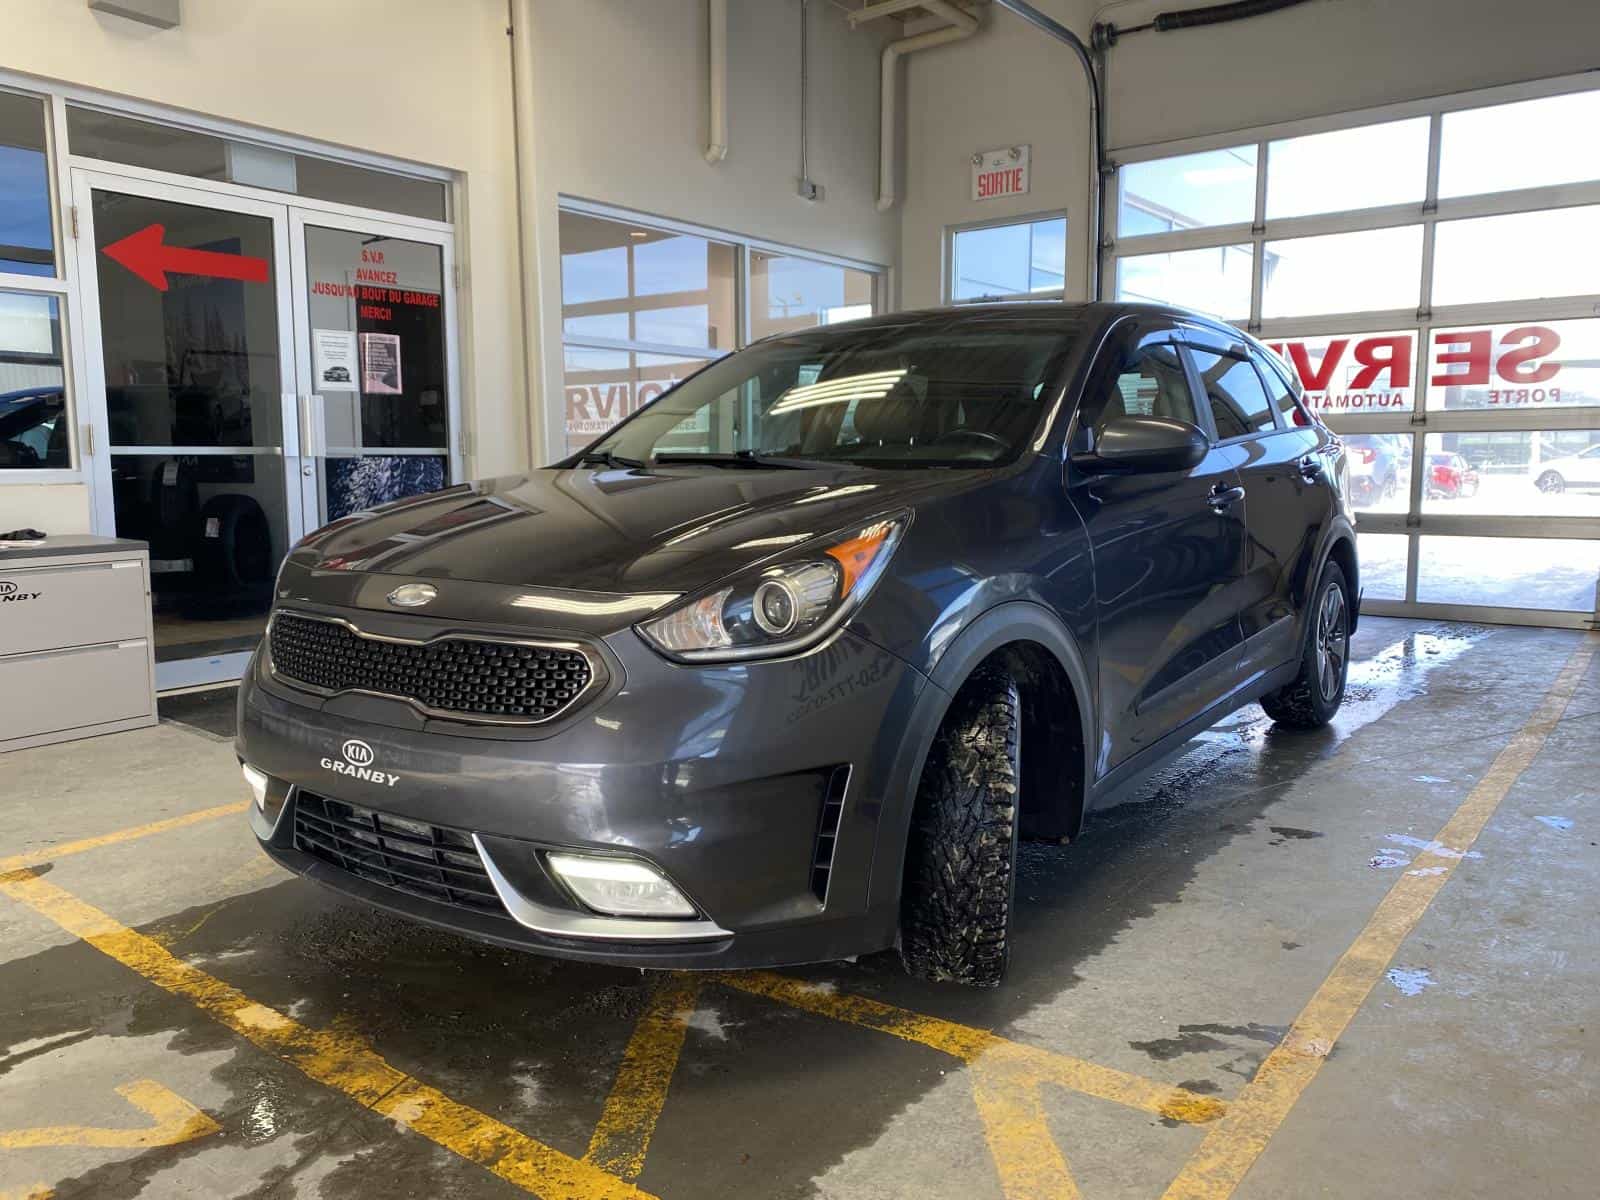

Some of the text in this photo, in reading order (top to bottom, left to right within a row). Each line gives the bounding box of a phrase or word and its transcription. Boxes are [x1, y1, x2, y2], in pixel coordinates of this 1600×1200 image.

[977, 167, 1024, 197] SORTIE
[356, 268, 398, 284] AVANCEZ
[361, 287, 387, 302] BOUT
[389, 290, 401, 303] DU
[403, 292, 439, 307] GARAGE
[320, 757, 400, 787] GRANBY
